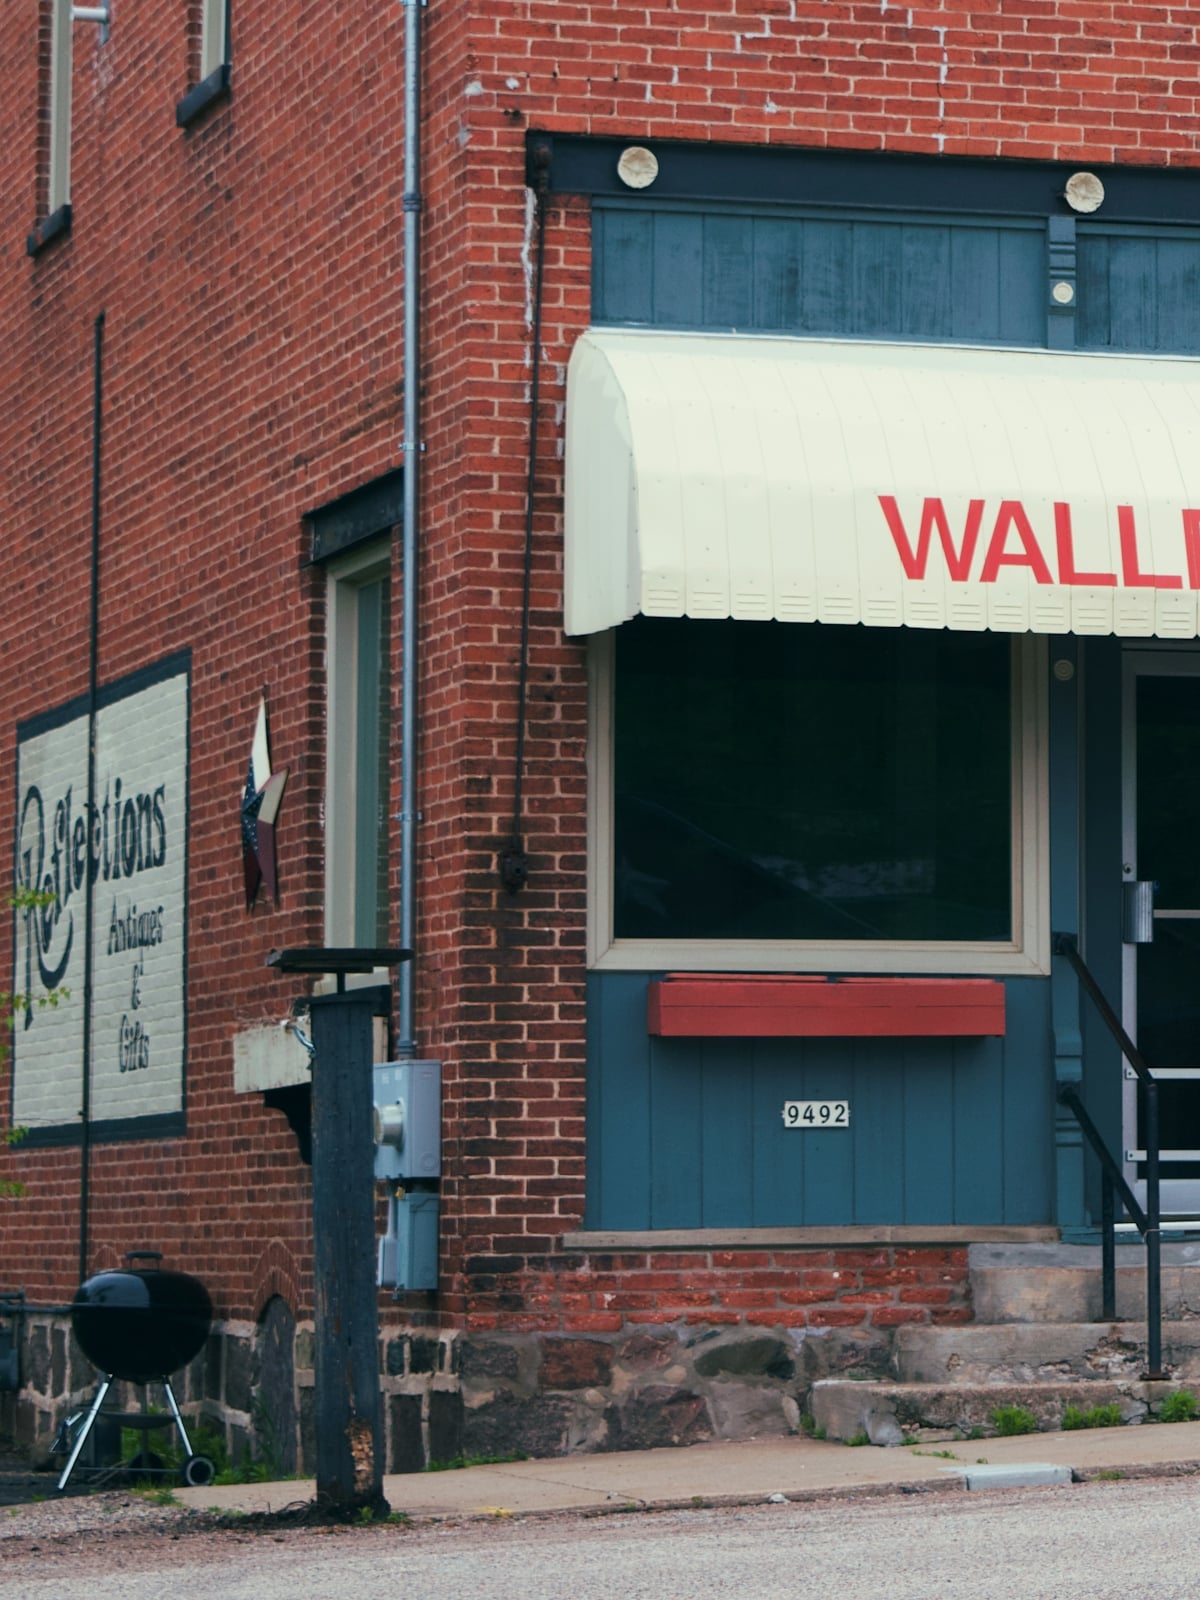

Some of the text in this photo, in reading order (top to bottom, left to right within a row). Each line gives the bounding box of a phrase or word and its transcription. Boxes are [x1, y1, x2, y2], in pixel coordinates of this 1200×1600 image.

[107, 894, 163, 975] Antiques
[131, 964, 141, 1010] &
[119, 1014, 150, 1072] Gifts
[787, 1104, 846, 1124] 9492
